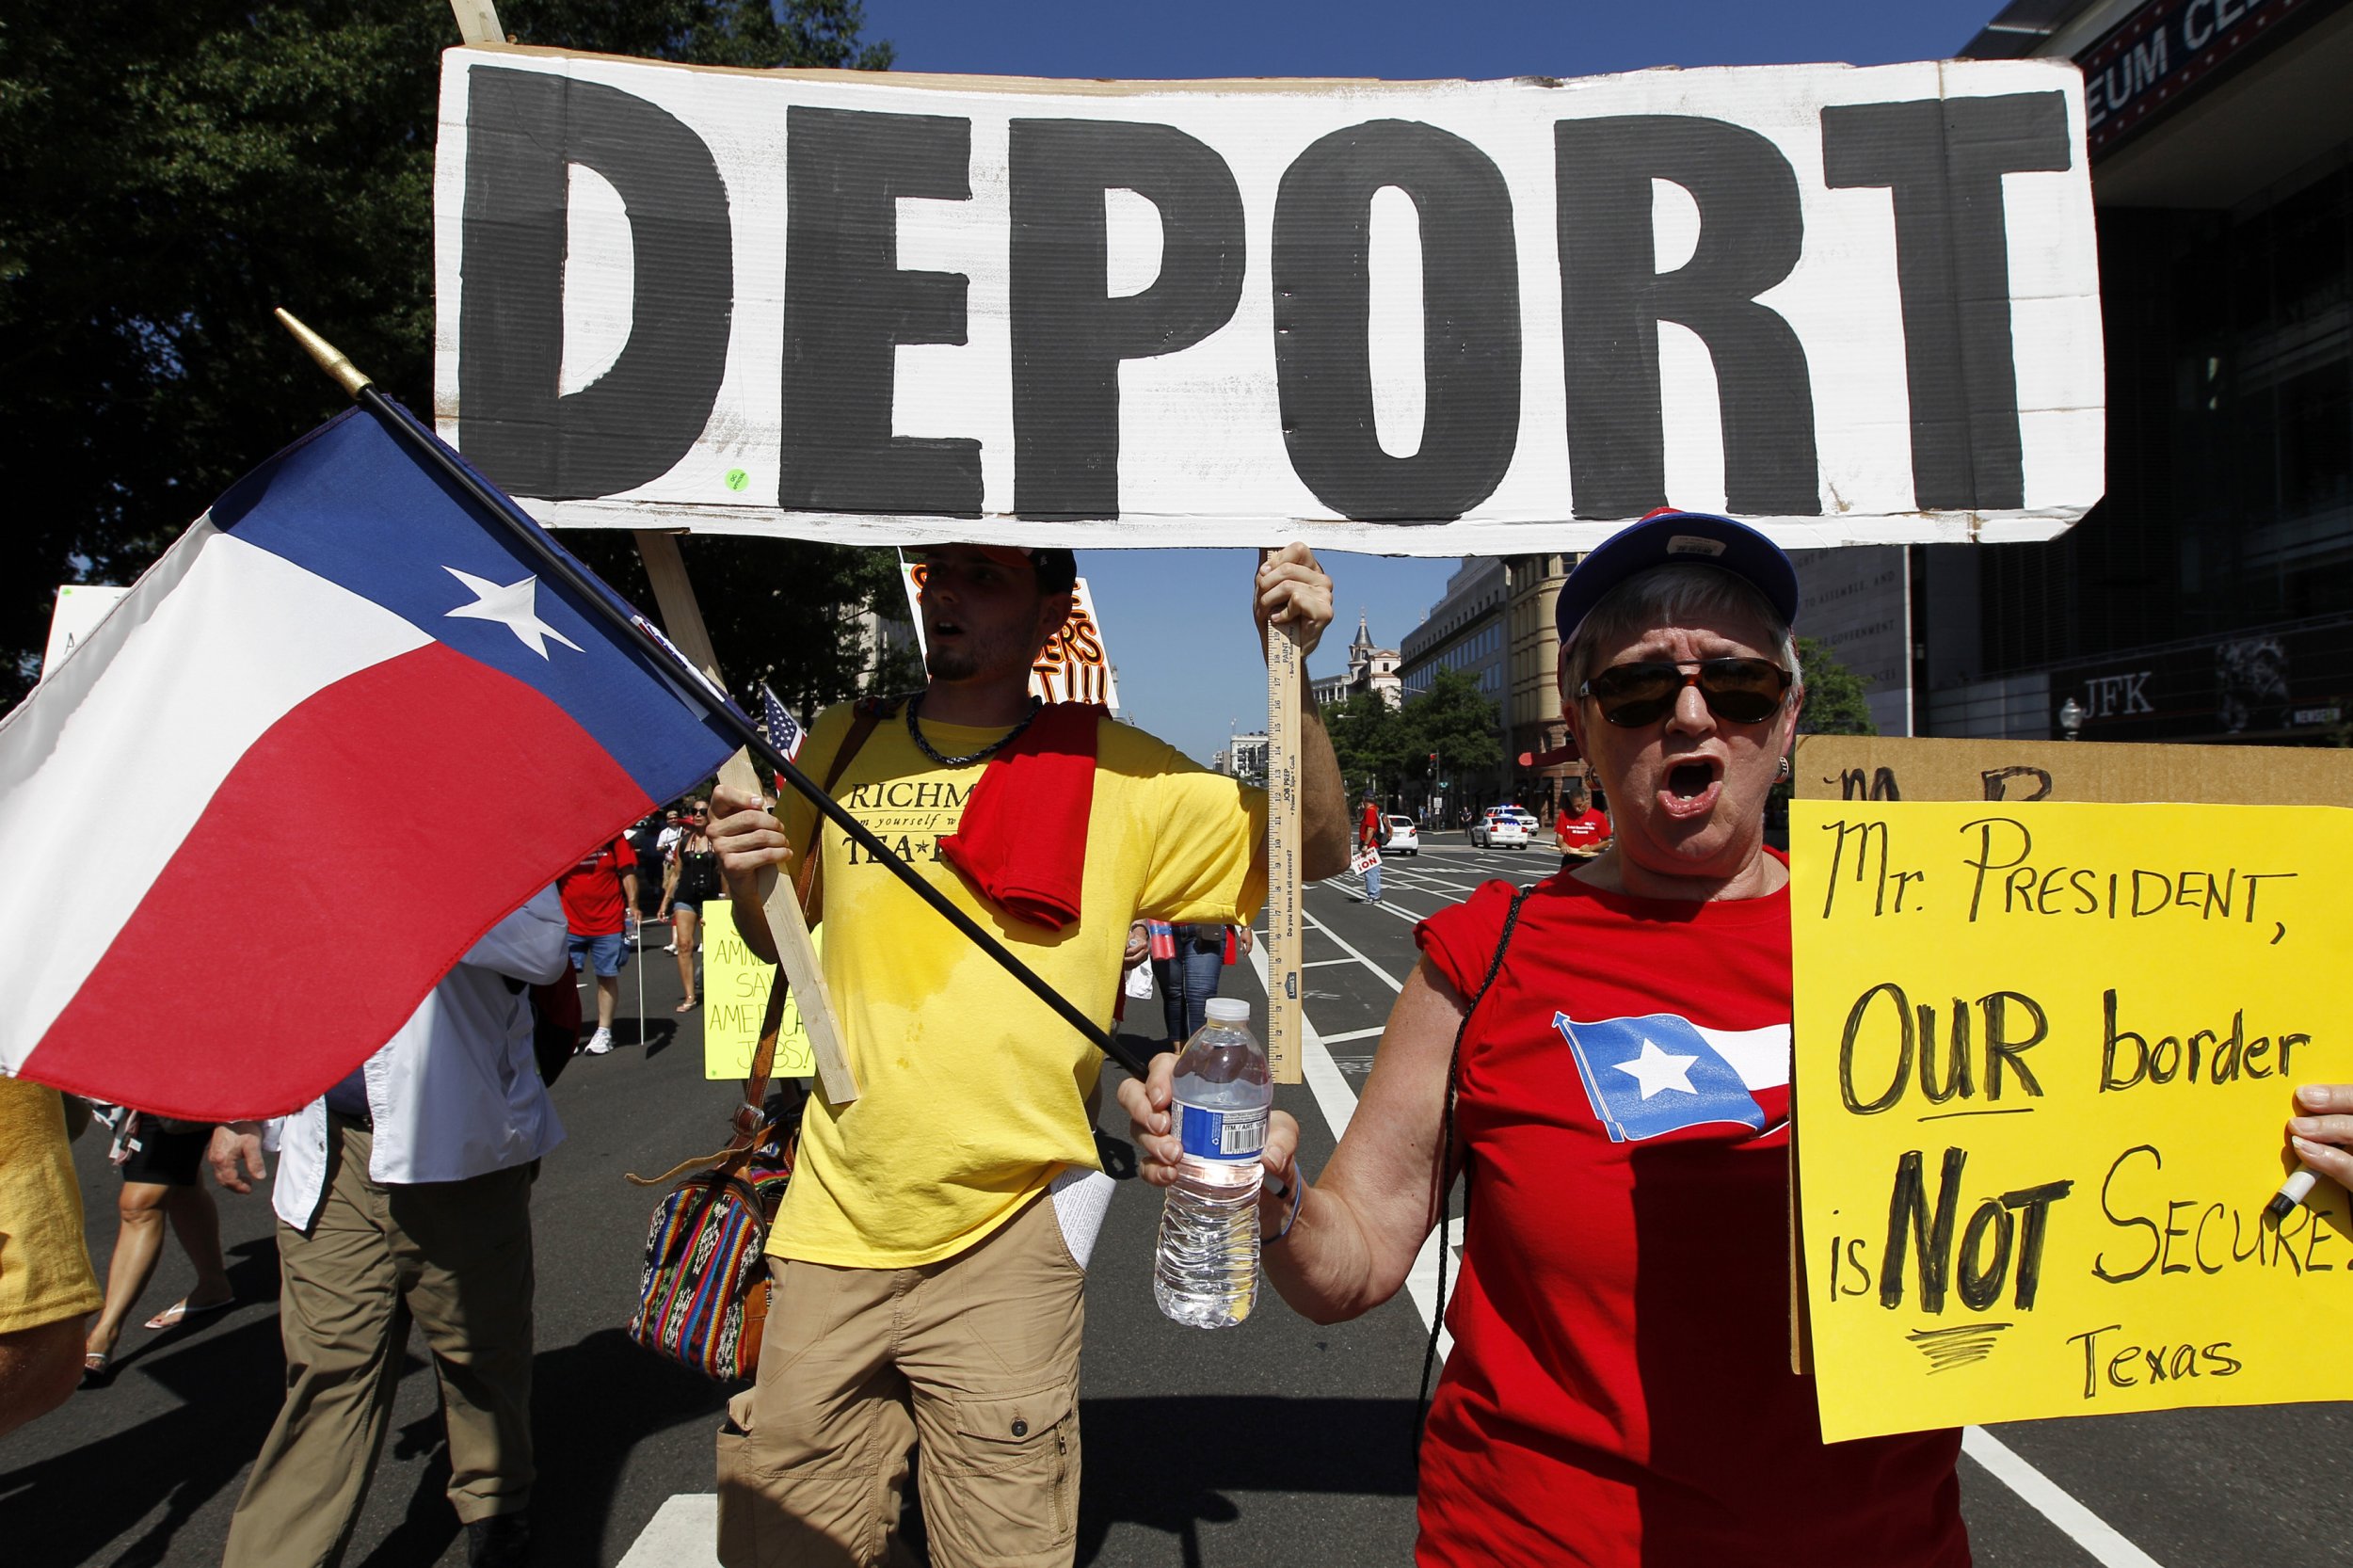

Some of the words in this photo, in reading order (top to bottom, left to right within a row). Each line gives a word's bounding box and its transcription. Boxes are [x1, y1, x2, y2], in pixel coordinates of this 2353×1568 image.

[458, 71, 2071, 526] DEPORT
[1874, 570, 1896, 585] AND
[1274, 632, 1281, 641] 19
[1274, 654, 1281, 664] 18
[1274, 678, 1281, 687] 17
[2083, 671, 2153, 719] JFK
[1274, 699, 1281, 709] 16
[1274, 723, 1281, 732] 15
[1275, 745, 1281, 755] 14
[1275, 769, 1281, 778] 13
[847, 782, 977, 809] RICHM
[1275, 792, 1281, 801] 12
[874, 813, 941, 830] yourself
[1275, 816, 1281, 825] 11
[1275, 839, 1281, 848] 10
[1357, 856, 1378, 872] NO!
[1821, 820, 1925, 920] Mr.
[1287, 927, 1292, 937] Do
[2097, 988, 2313, 1094] border
[737, 1039, 812, 1069] JBS!
[1829, 1209, 1872, 1303] is
[1878, 1144, 2075, 1317] NOT
[2065, 1323, 2243, 1400] Texas
